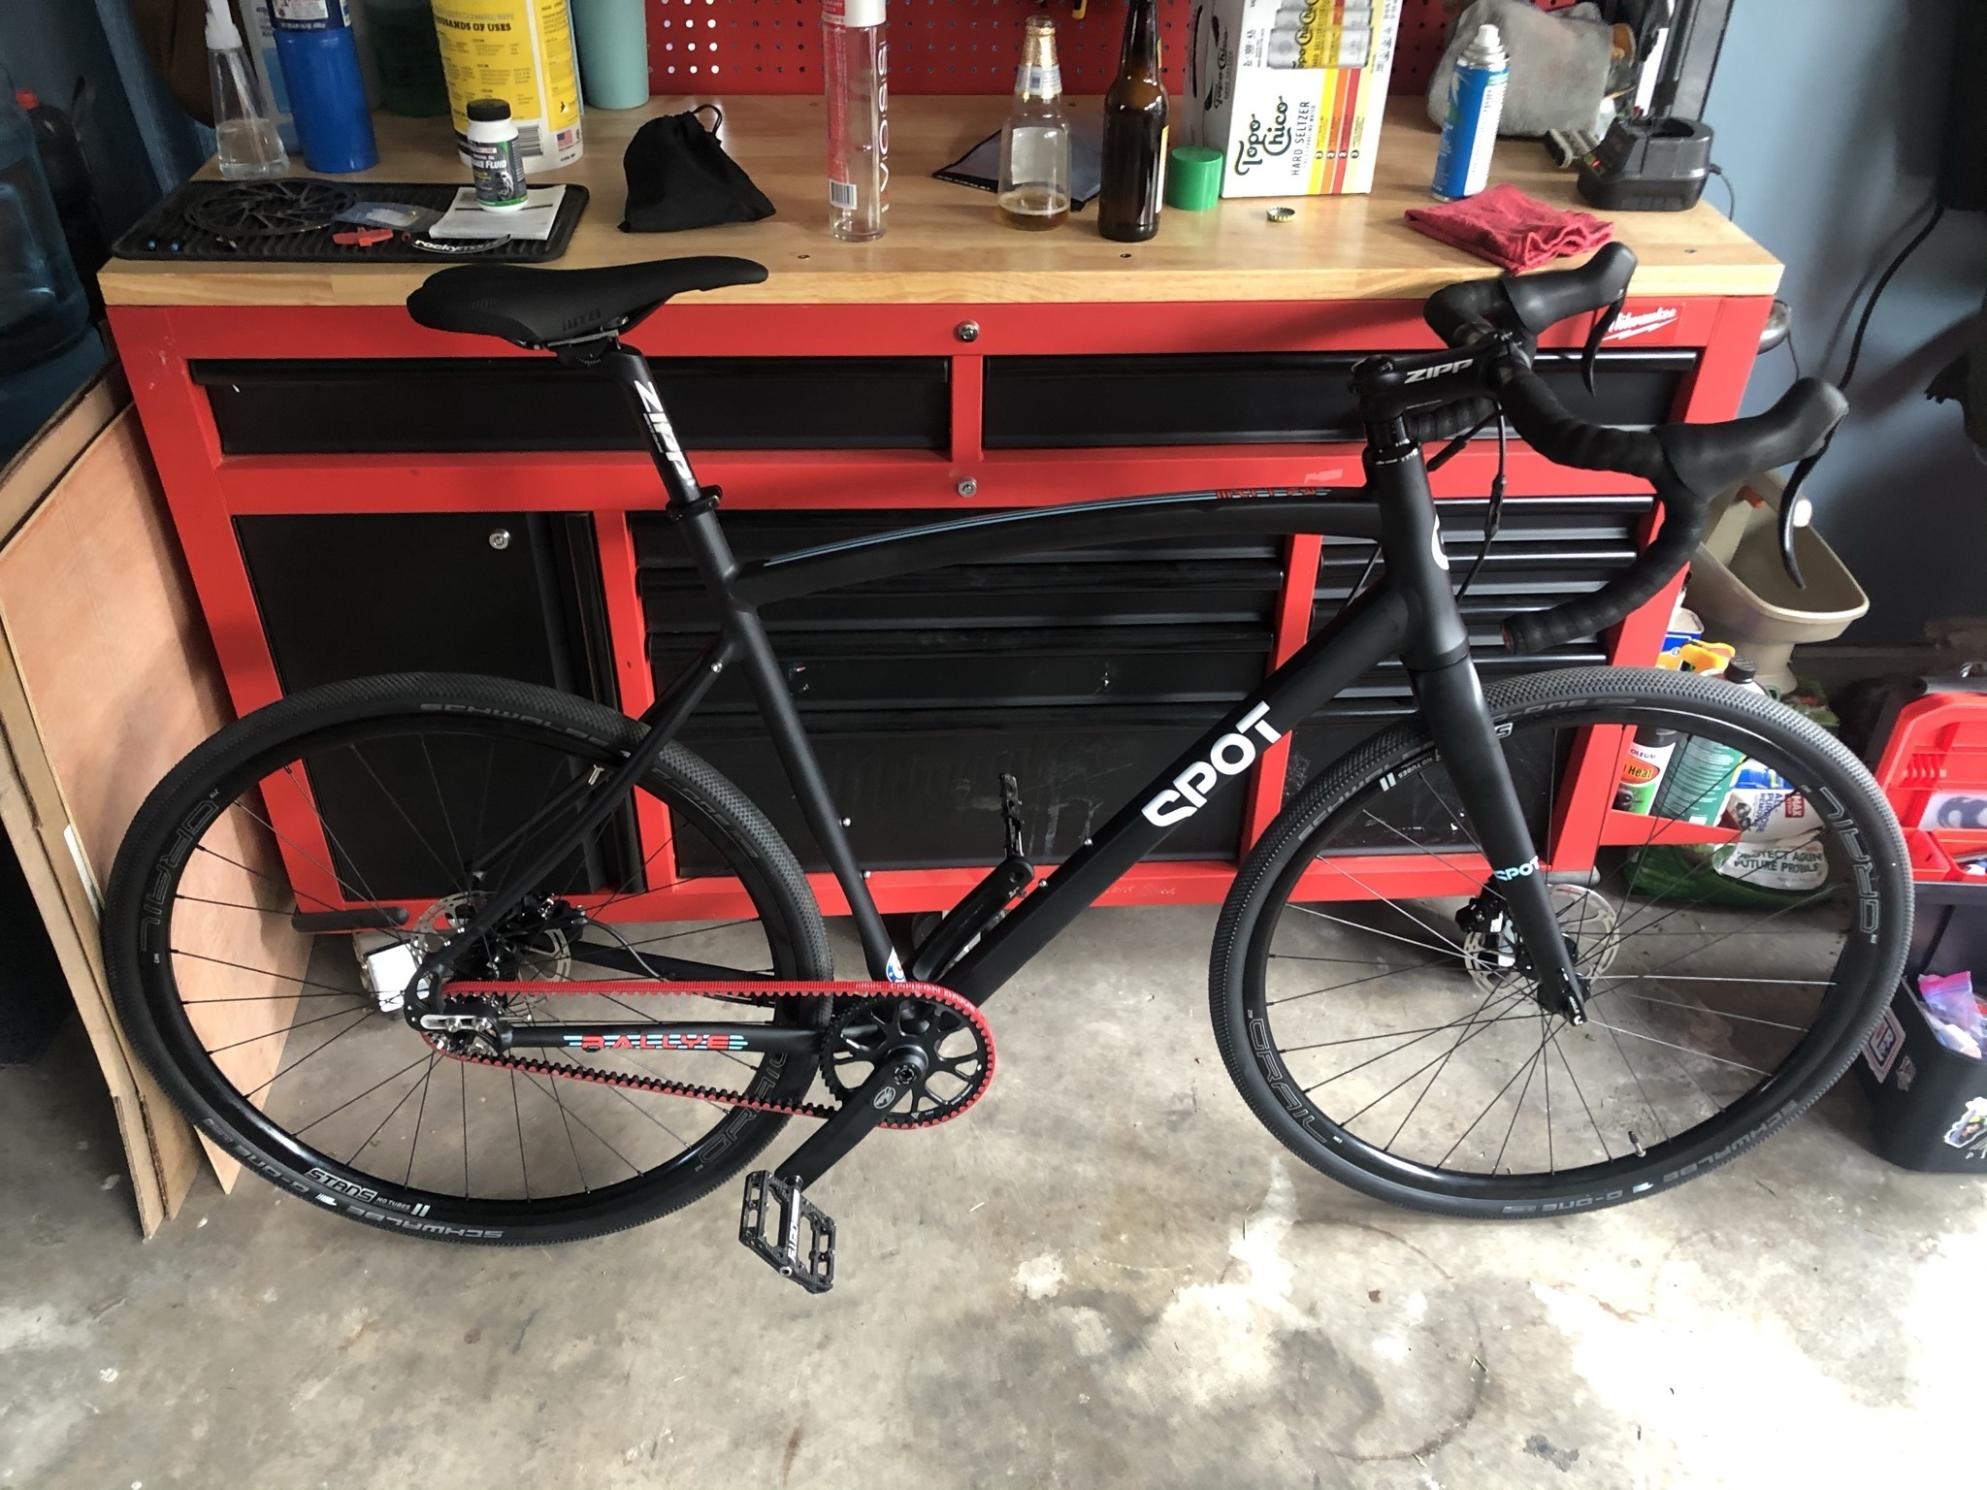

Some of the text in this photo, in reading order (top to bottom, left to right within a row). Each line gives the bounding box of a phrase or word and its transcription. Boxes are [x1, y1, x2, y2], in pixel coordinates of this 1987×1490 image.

[473, 22, 485, 32] OF
[487, 22, 512, 32] USES
[1234, 113, 1264, 176] Topo
[1262, 95, 1293, 157] Chico
[1290, 100, 1311, 177] HARD SELTZER
[485, 160, 507, 169] FLUID
[1404, 358, 1474, 384] ZIPP
[634, 379, 693, 481] ZIPP
[1141, 701, 1282, 827] SPOT
[1791, 795, 1803, 817] MAX
[1494, 855, 1539, 880] SPOT
[581, 1033, 730, 1050] RALLYE
[1249, 1018, 1328, 1144] GRAIL
[1662, 1099, 1799, 1184] SCHWALBE
[346, 1204, 504, 1240] SCHWALBE
